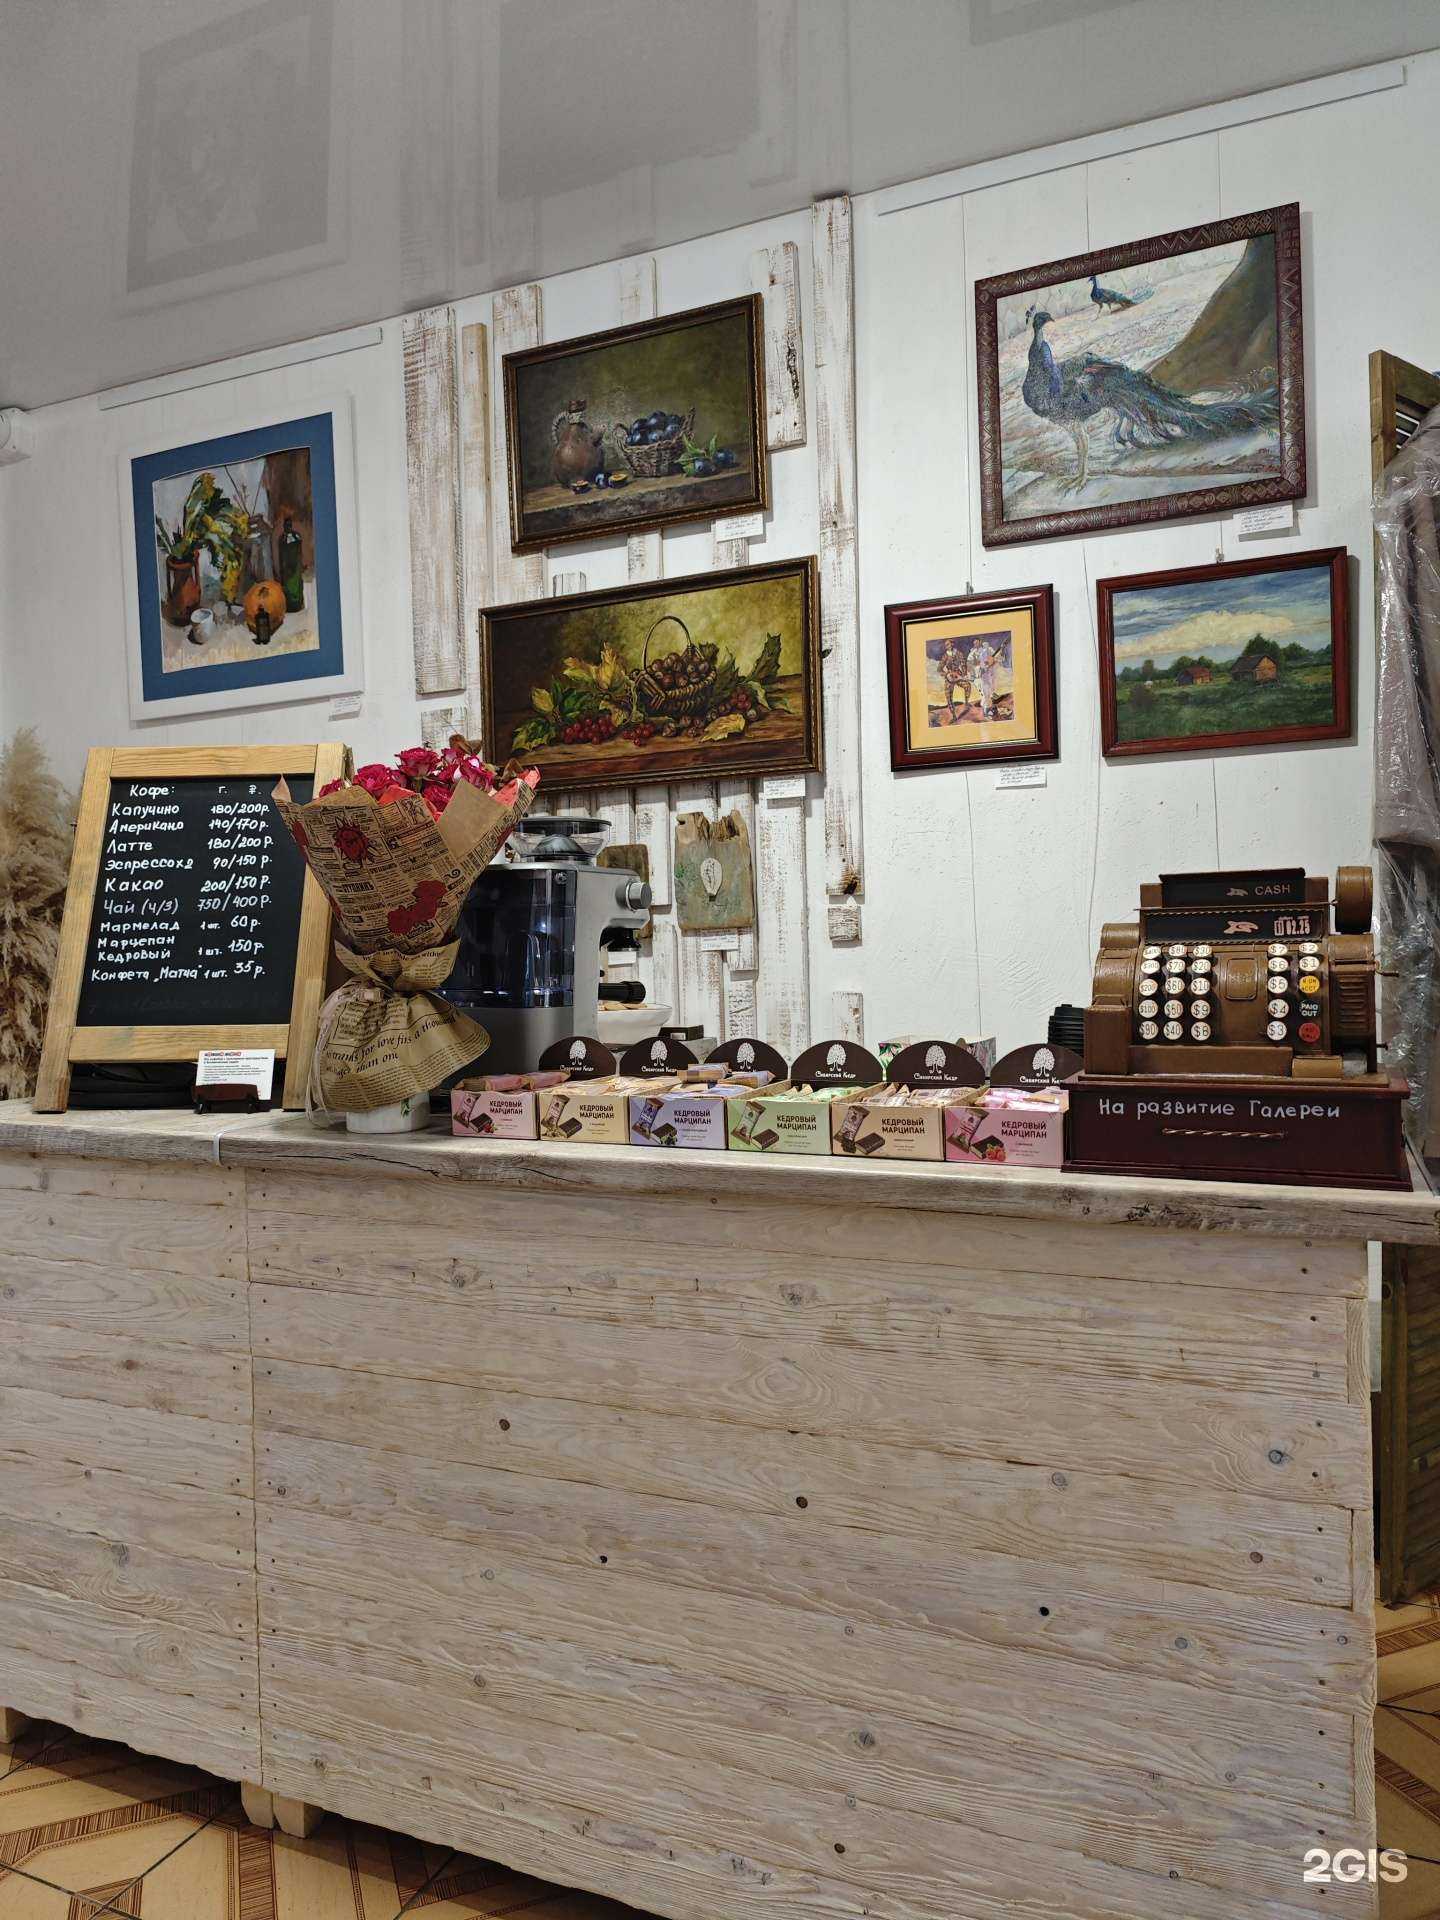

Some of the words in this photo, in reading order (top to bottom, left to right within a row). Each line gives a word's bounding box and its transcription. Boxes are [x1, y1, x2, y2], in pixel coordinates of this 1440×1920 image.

[130, 784, 175, 800] Кофе:
[111, 803, 180, 819] Капучино
[109, 818, 184, 835] Американо
[106, 839, 153, 854] Латте
[213, 853, 257, 869] 90/150
[104, 878, 164, 893] Какао
[200, 873, 257, 893] 200/150
[1255, 884, 1291, 896] CASH
[103, 899, 135, 915] Чай
[100, 921, 180, 934] Мармелад
[200, 921, 206, 930] 1
[230, 915, 248, 928] 60
[97, 935, 175, 950] Марцепан
[98, 948, 171, 964] Кедровый
[198, 947, 203, 956] 1
[205, 948, 222, 956] шт.
[227, 939, 252, 953] 150
[91, 968, 150, 982] Конфета
[204, 969, 210, 979] 1
[211, 969, 228, 978] шт.
[233, 960, 254, 974] 35
[1270, 960, 1287, 970] $6
[1192, 980, 1209, 991] $10
[1269, 978, 1287, 990] $5
[1193, 1004, 1209, 1016] $9
[1271, 1002, 1287, 1015] $4
[1165, 1024, 1181, 1036] $40
[1269, 1024, 1284, 1036] $3
[489, 1100, 523, 1108] КЕДРОВЫЙ
[579, 1104, 614, 1112] КЕДРОВЫЙ
[1099, 1098, 1124, 1115] На
[1137, 1100, 1235, 1120] развитие
[1249, 1100, 1340, 1119] Галереи
[489, 1107, 523, 1115] МАРЦИПАН
[579, 1111, 615, 1119] МАРЦИПАН
[674, 1109, 711, 1117] КЕДРОВЫЙ
[674, 1117, 712, 1125] МАРЦИПАН
[776, 1114, 816, 1123] КЕДРОВЫЙ
[881, 1117, 924, 1126] КЕДРОВЫЙ
[776, 1122, 817, 1131] МАРЦИПАН
[881, 1125, 926, 1134] МАРЦИПАН
[1001, 1120, 1047, 1130] КЕДРОВЫЙ
[1001, 1129, 1047, 1139] МАРЦИПАН
